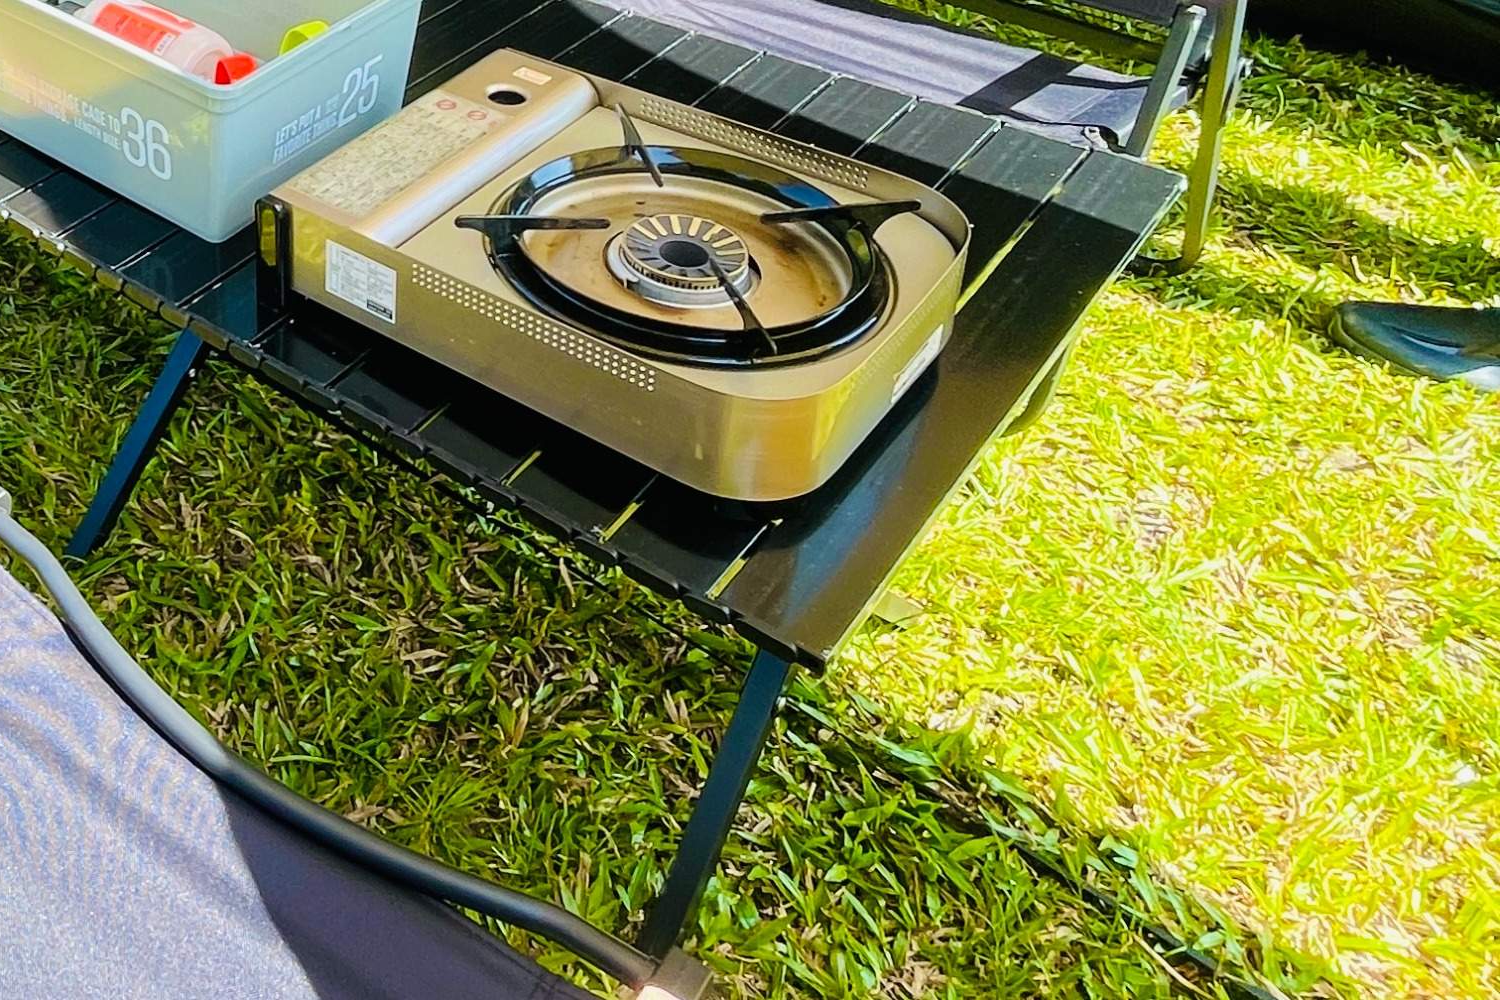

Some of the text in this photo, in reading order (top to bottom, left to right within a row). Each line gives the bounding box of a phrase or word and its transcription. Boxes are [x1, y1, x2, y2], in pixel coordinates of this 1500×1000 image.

[107, 114, 121, 135] TO
[338, 54, 383, 128] 25
[121, 106, 172, 181] 36
